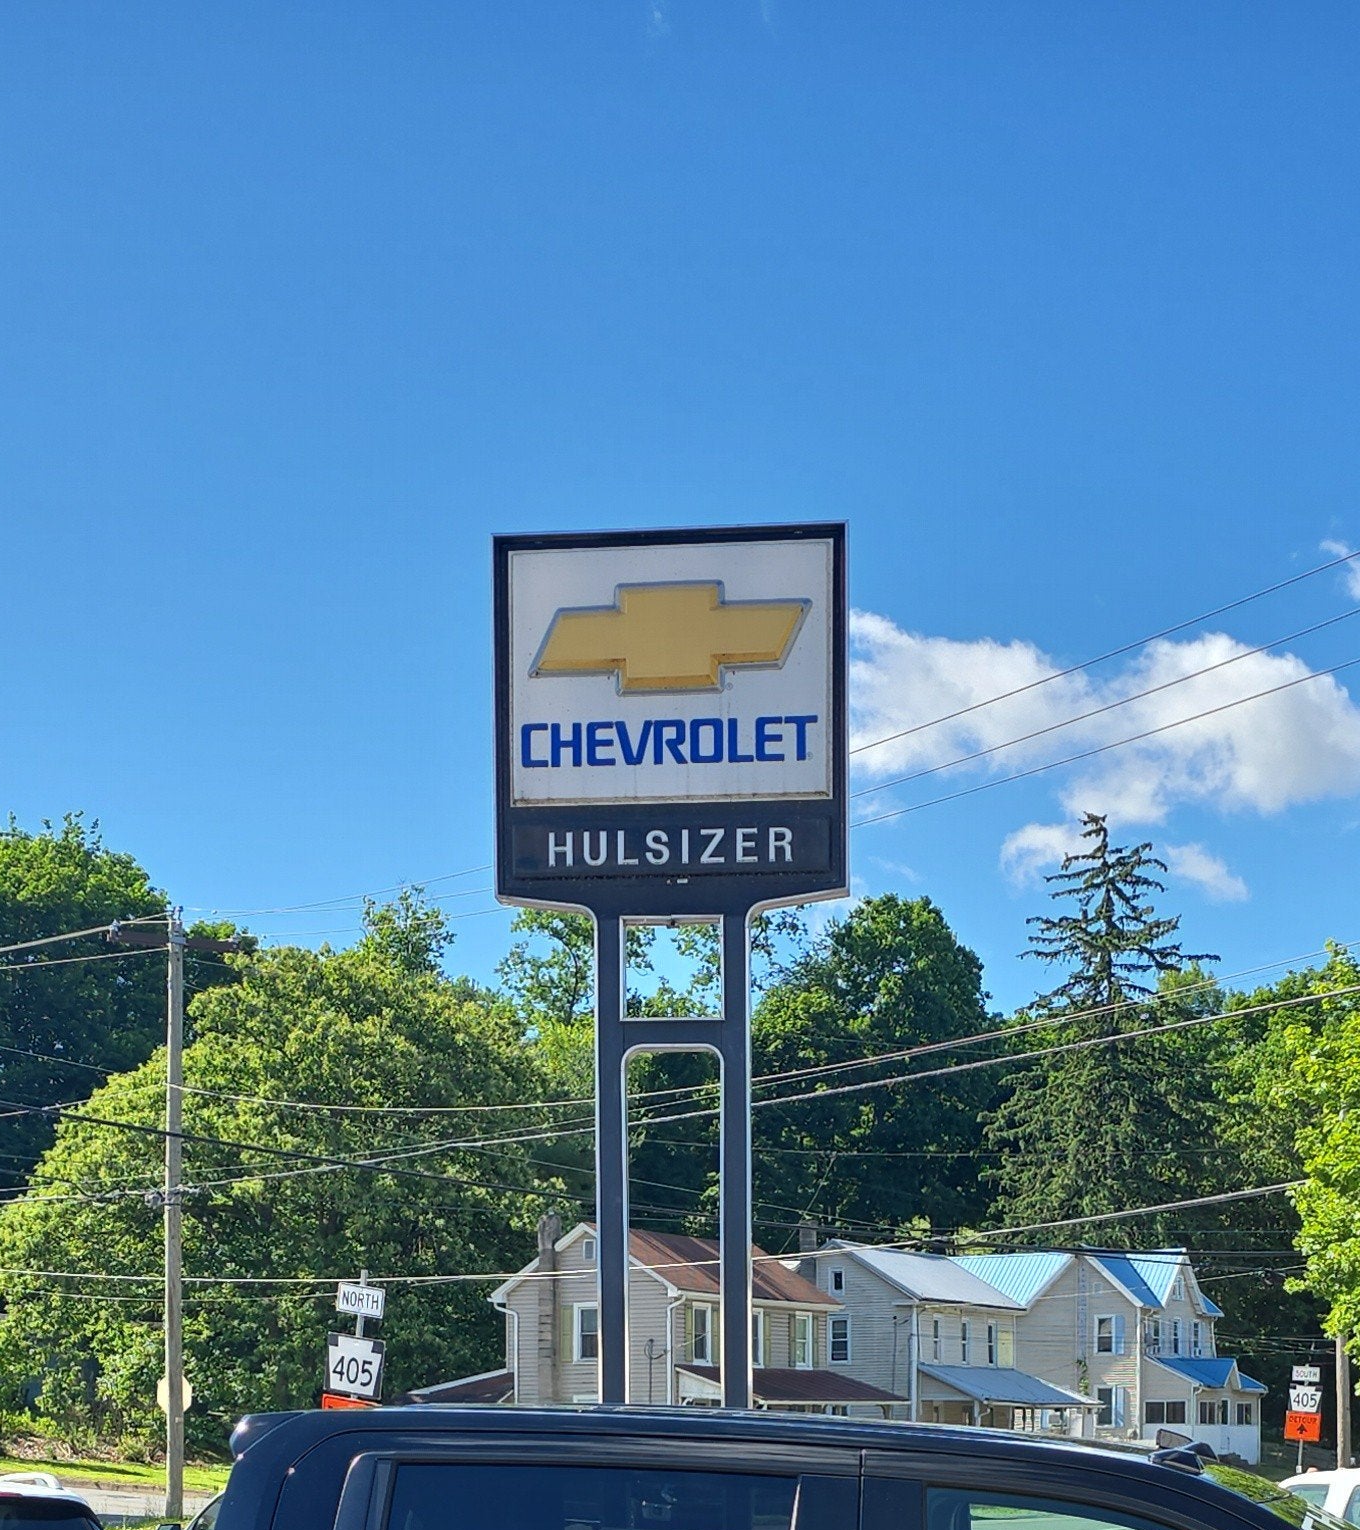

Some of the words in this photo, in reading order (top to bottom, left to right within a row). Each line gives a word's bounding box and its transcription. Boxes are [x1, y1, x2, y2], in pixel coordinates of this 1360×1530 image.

[521, 715, 819, 768] CHEVROLET
[548, 827, 795, 867] HULSIZER
[342, 1290, 379, 1310] NORTH
[332, 1356, 373, 1387] 405
[1294, 1370, 1319, 1379] SOUTH
[1293, 1392, 1318, 1409] 405
[1289, 1415, 1318, 1425] DETOUR
